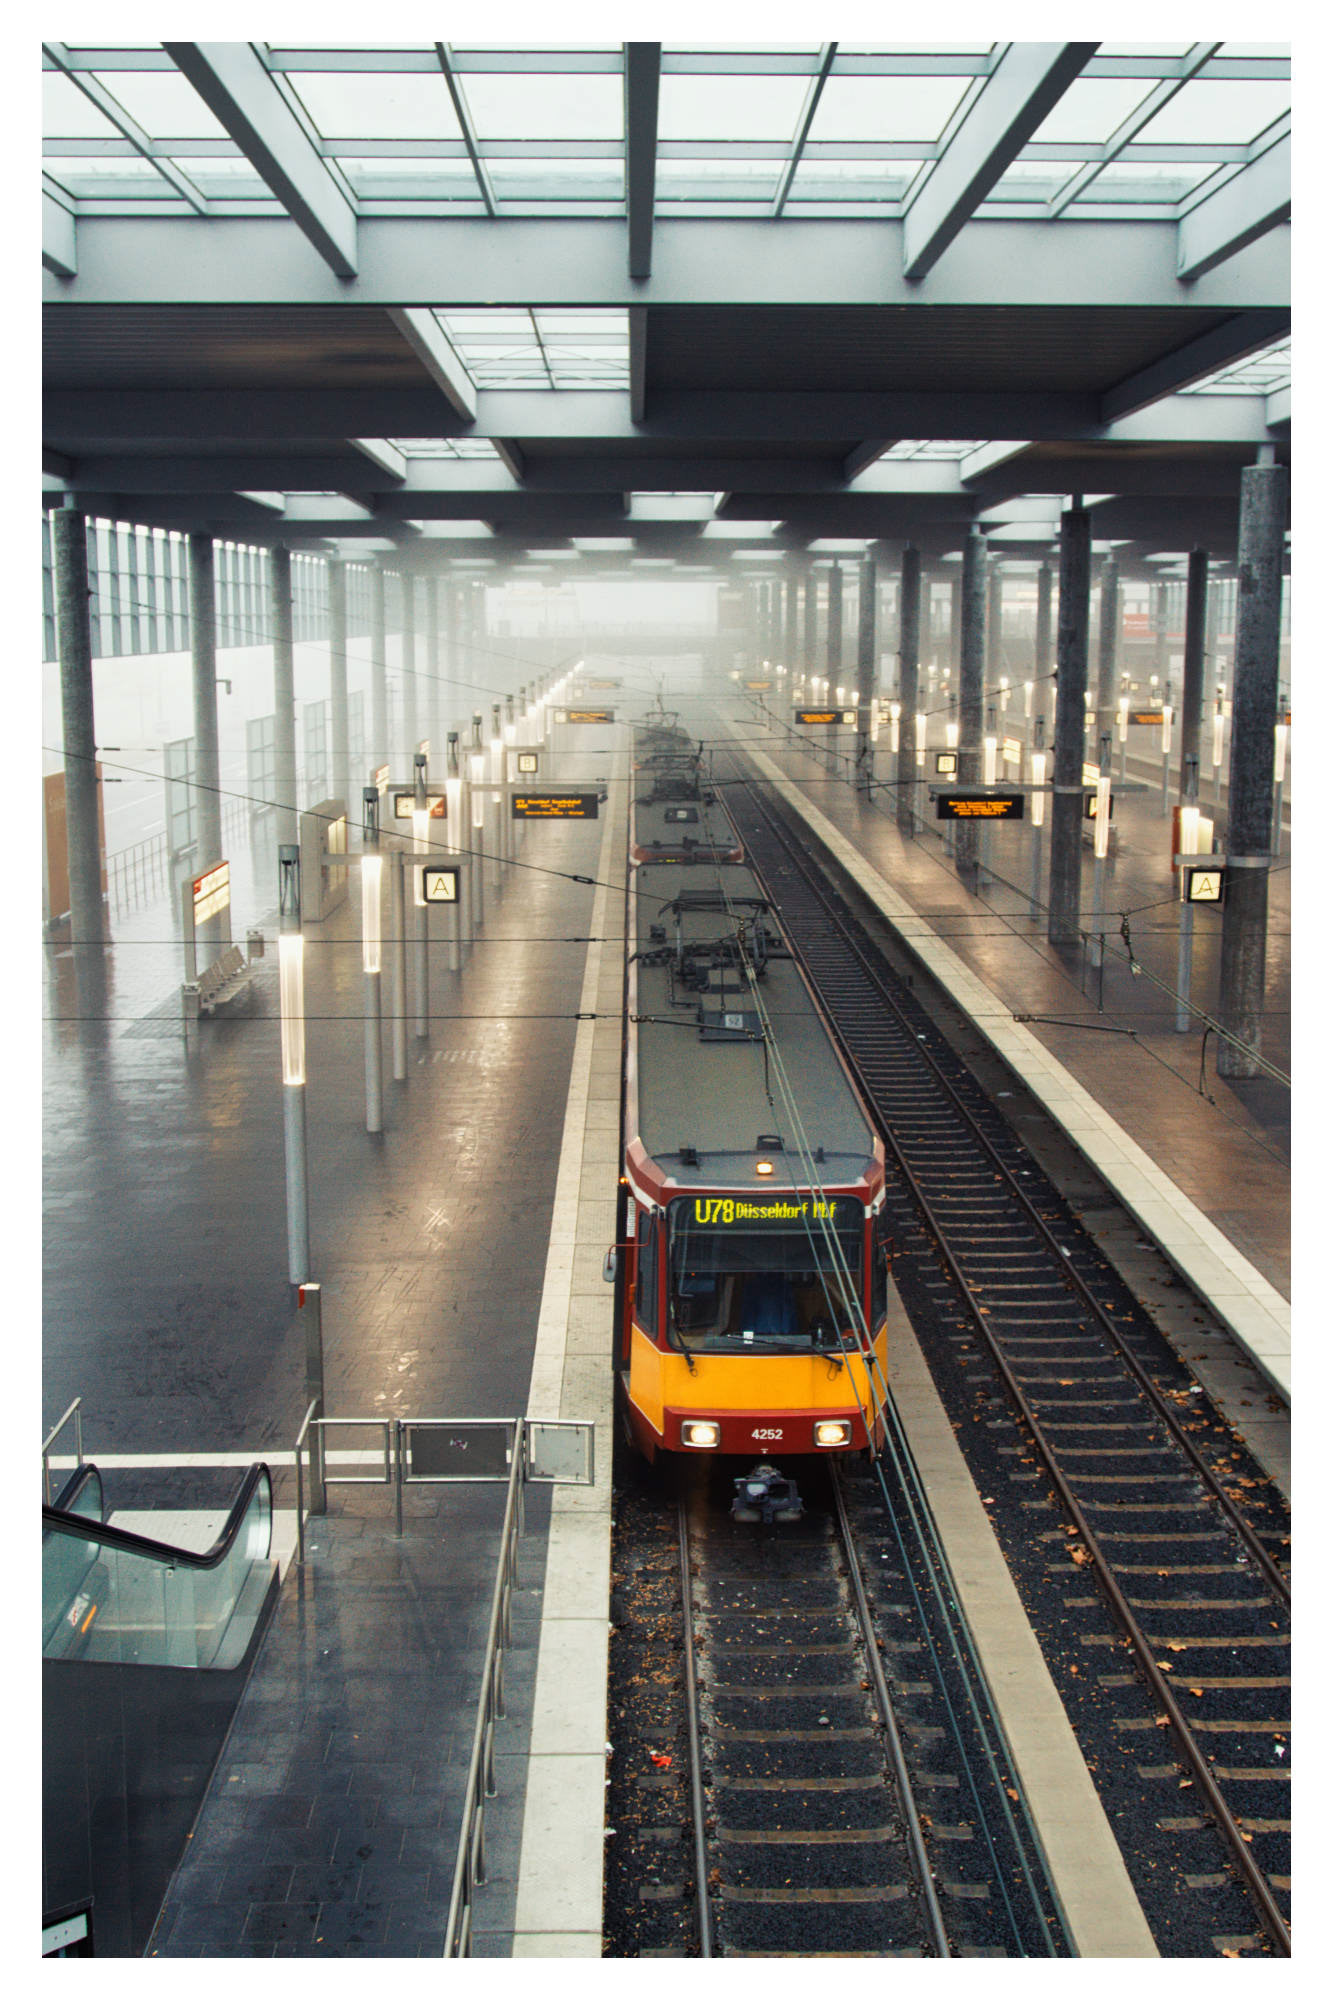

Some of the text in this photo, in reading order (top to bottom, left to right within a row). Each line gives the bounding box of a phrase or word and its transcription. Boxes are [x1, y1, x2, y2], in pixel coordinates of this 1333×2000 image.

[433, 877, 449, 894] A
[1197, 877, 1213, 894] A
[695, 1199, 734, 1223] U78
[735, 1202, 809, 1219] Düsseldorf
[751, 1428, 783, 1440] 4252
